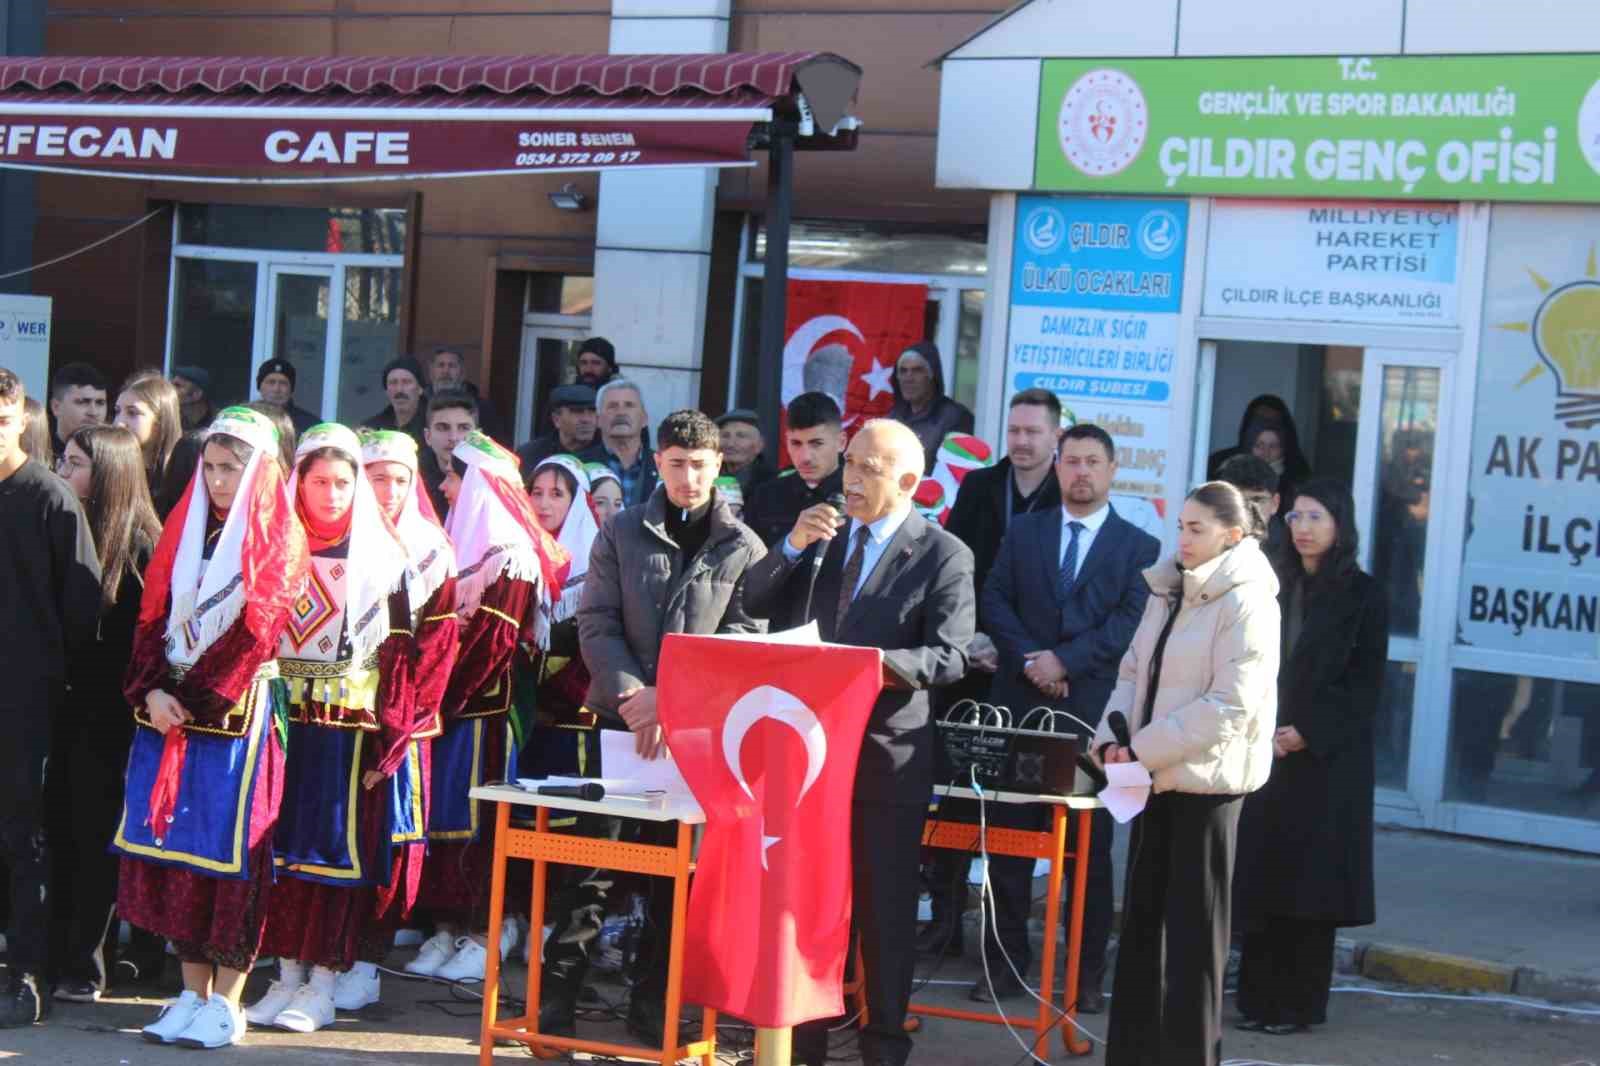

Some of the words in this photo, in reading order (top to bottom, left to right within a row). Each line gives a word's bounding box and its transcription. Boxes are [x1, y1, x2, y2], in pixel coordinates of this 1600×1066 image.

[1337, 57, 1377, 80] T.C.
[1198, 84, 1290, 121] GENÇLİK
[1294, 92, 1324, 115] VE
[1327, 92, 1387, 117] SPOR
[1391, 85, 1516, 117] BAKANLIĞI
[0, 125, 177, 159] FECAN
[263, 130, 409, 164] CAFE
[519, 132, 577, 147] SONER
[515, 152, 556, 166] 0534
[557, 151, 591, 164] 372
[1158, 136, 1296, 188] ÇILDIR
[1304, 138, 1428, 193] GENÇ
[1436, 126, 1557, 184] OFİSİ
[1069, 222, 1130, 252] ÇILDIR
[1316, 231, 1440, 249] HAREKET
[1326, 251, 1427, 273] PARTİSİ
[1022, 261, 1073, 292] ÜLKÜ
[1074, 269, 1172, 297] OCAKLARI
[1221, 287, 1279, 304] ÇILDIR
[1284, 286, 1323, 306] İLÇE
[1328, 290, 1441, 310] BAŞKANLIĞI
[1041, 315, 1108, 337] DAMIZLIK
[1484, 434, 1544, 480] AK
[1555, 438, 1600, 483] PA
[1522, 504, 1600, 567] İLÇ
